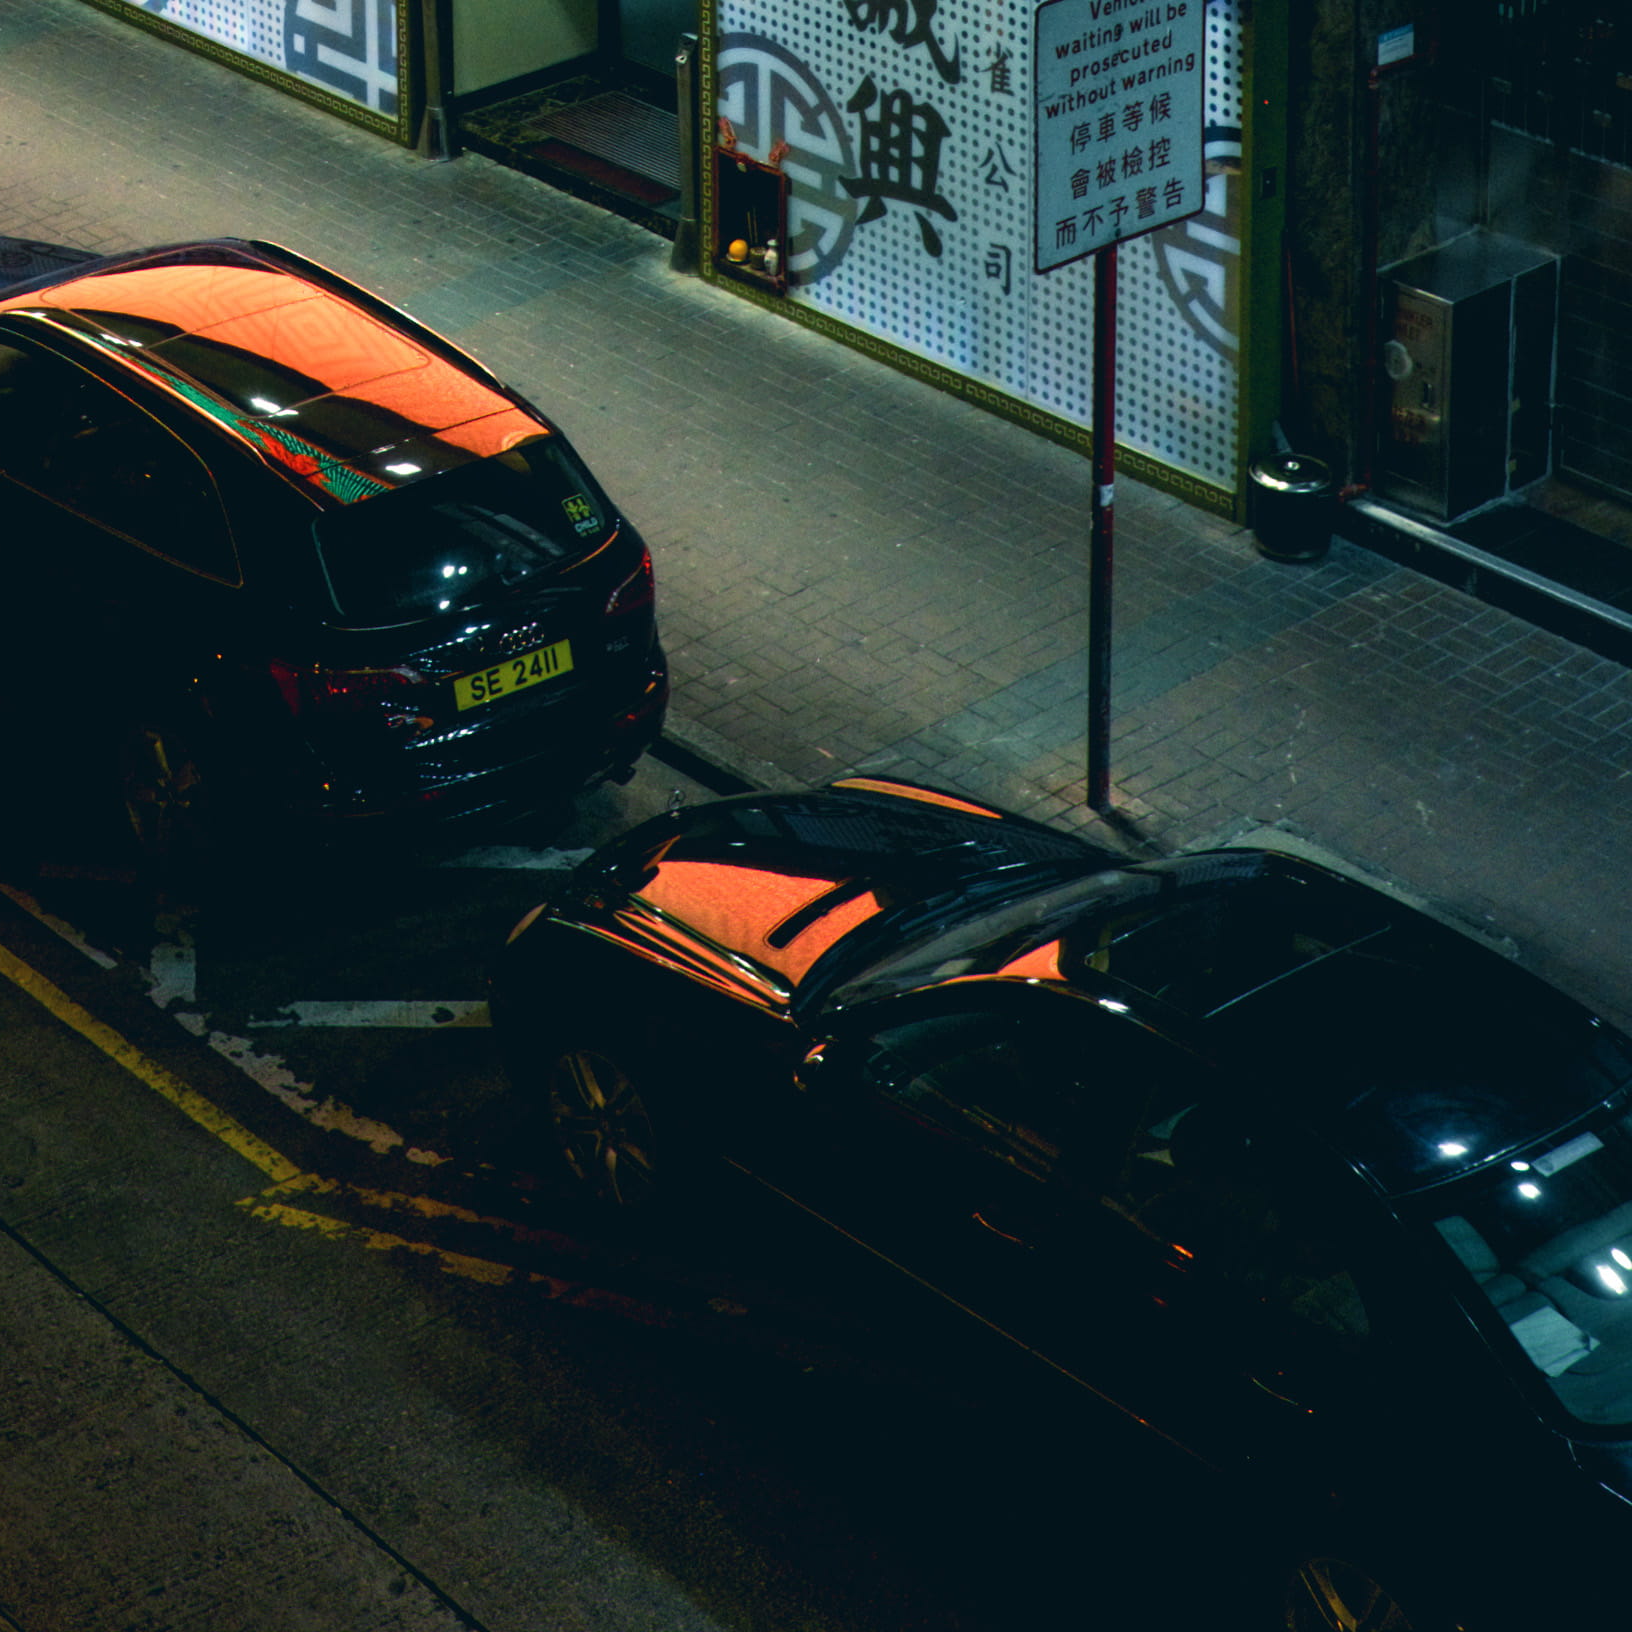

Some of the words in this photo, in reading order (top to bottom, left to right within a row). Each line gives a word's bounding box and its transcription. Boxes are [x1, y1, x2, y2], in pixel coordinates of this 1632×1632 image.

[1055, 23, 1123, 60] waiting
[1129, 7, 1161, 33] will
[1166, 2, 1188, 22] be
[1070, 29, 1173, 87] prosecuted
[1045, 78, 1116, 119] without
[1121, 52, 1196, 91] warning
[1070, 92, 1172, 155] 停車等候
[1070, 136, 1171, 201] 會被檢控
[1055, 177, 1185, 250] 而不予警告
[470, 668, 503, 701] SE
[512, 646, 559, 687] 2411
